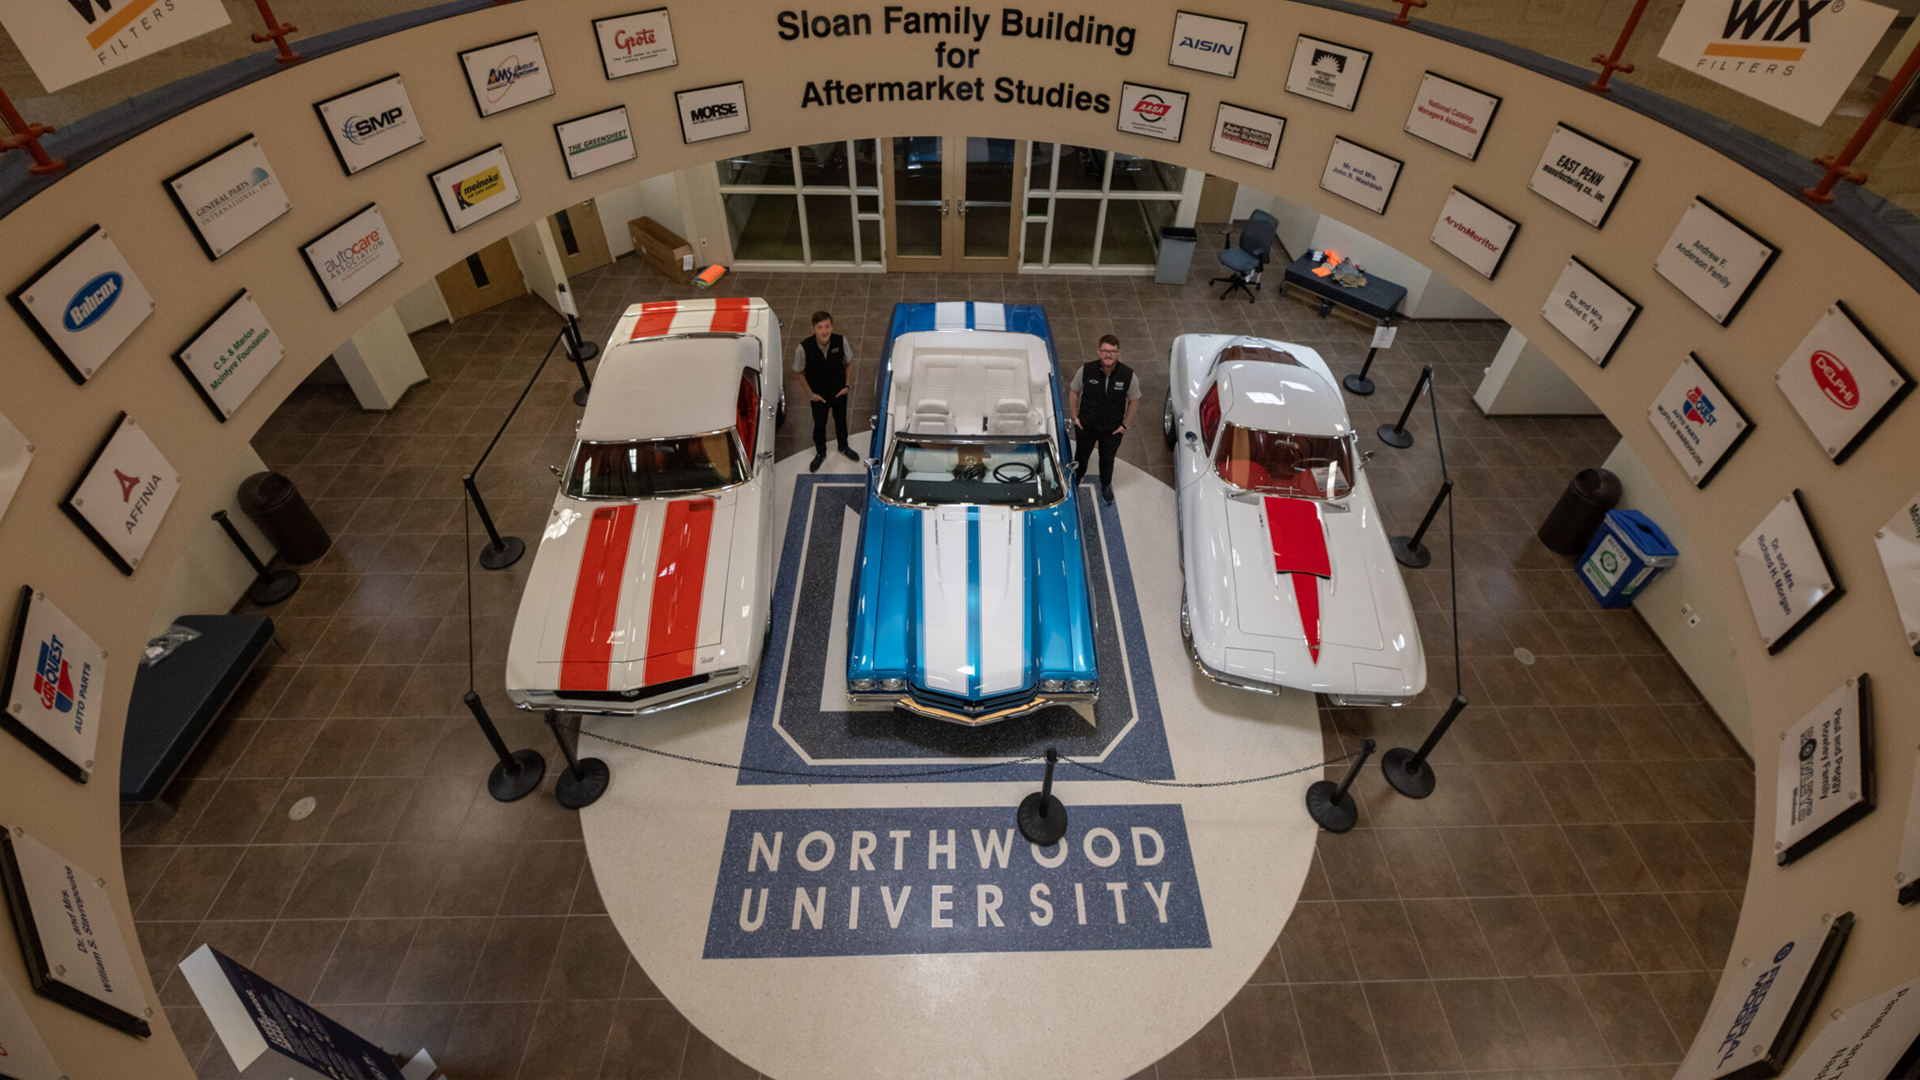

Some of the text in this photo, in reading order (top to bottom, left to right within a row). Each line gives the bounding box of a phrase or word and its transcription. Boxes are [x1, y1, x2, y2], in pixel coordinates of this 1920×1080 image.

[97, 0, 175, 65] FILTERS
[777, 5, 1137, 56] Sloan Family Building
[1721, 0, 1833, 43] WIX
[614, 28, 657, 55] Grote
[935, 41, 980, 69] for
[1179, 36, 1233, 56] AISIN
[487, 67, 513, 85] AMS
[1696, 59, 1795, 76] FILTERS
[690, 102, 738, 121] MORSE
[801, 75, 1111, 114] Aftermarket Studies
[1138, 103, 1165, 114] AASA
[1428, 99, 1473, 124] National Catalog
[355, 106, 403, 136] SMP
[1418, 105, 1477, 135] Managers Association
[568, 129, 627, 152] THE GREENSHEET
[464, 173, 499, 195] meineke
[1332, 167, 1347, 176] John
[1342, 161, 1377, 181] Mr. and Mrs.
[1542, 164, 1584, 192] manufacturing
[1556, 154, 1605, 187] EAST PENN
[196, 180, 251, 217] GENERAL PARTS
[324, 230, 380, 273] autocare
[1444, 215, 1499, 252] ArvinMeritor
[331, 239, 384, 279] ASSOCIATION
[1676, 242, 1731, 288] Anderson Family
[1693, 240, 1727, 268] Andrew F.
[69, 277, 118, 326] Babcox
[1565, 299, 1583, 317] David
[1588, 319, 1600, 332] Fry
[1569, 291, 1603, 323] Dr. and Mrs.
[210, 328, 270, 391] McIntyre Foundation
[213, 328, 255, 371] C.S. & Marion
[1815, 356, 1854, 402] DELPHI
[1657, 404, 1704, 467] MUFFLER WAREHOUSE
[1672, 409, 1700, 445] AUTO PARTS
[126, 474, 162, 535] AFFINIA
[1608, 538, 1628, 563] RECYCLE
[1771, 538, 1794, 592] Dr. and Mrs.
[1757, 534, 1774, 569] Richard
[1774, 578, 1792, 616] Morgan
[74, 661, 92, 735] AUTO PARTS
[1819, 720, 1831, 800] Rowley Family
[1832, 707, 1843, 794] Paul and Peggy
[747, 827, 1166, 872] NORTHWOOD
[65, 865, 93, 936] Stavropoulos
[739, 881, 1171, 932] UNIVERSITY
[61, 888, 88, 954] Dr. and Mrs.
[93, 951, 113, 993] William
[1717, 971, 1769, 1053] MOGUL
[1717, 965, 1781, 1070] FEDERAL
[1860, 987, 1910, 1040] Pamela
[1836, 1042, 1864, 1071] and
